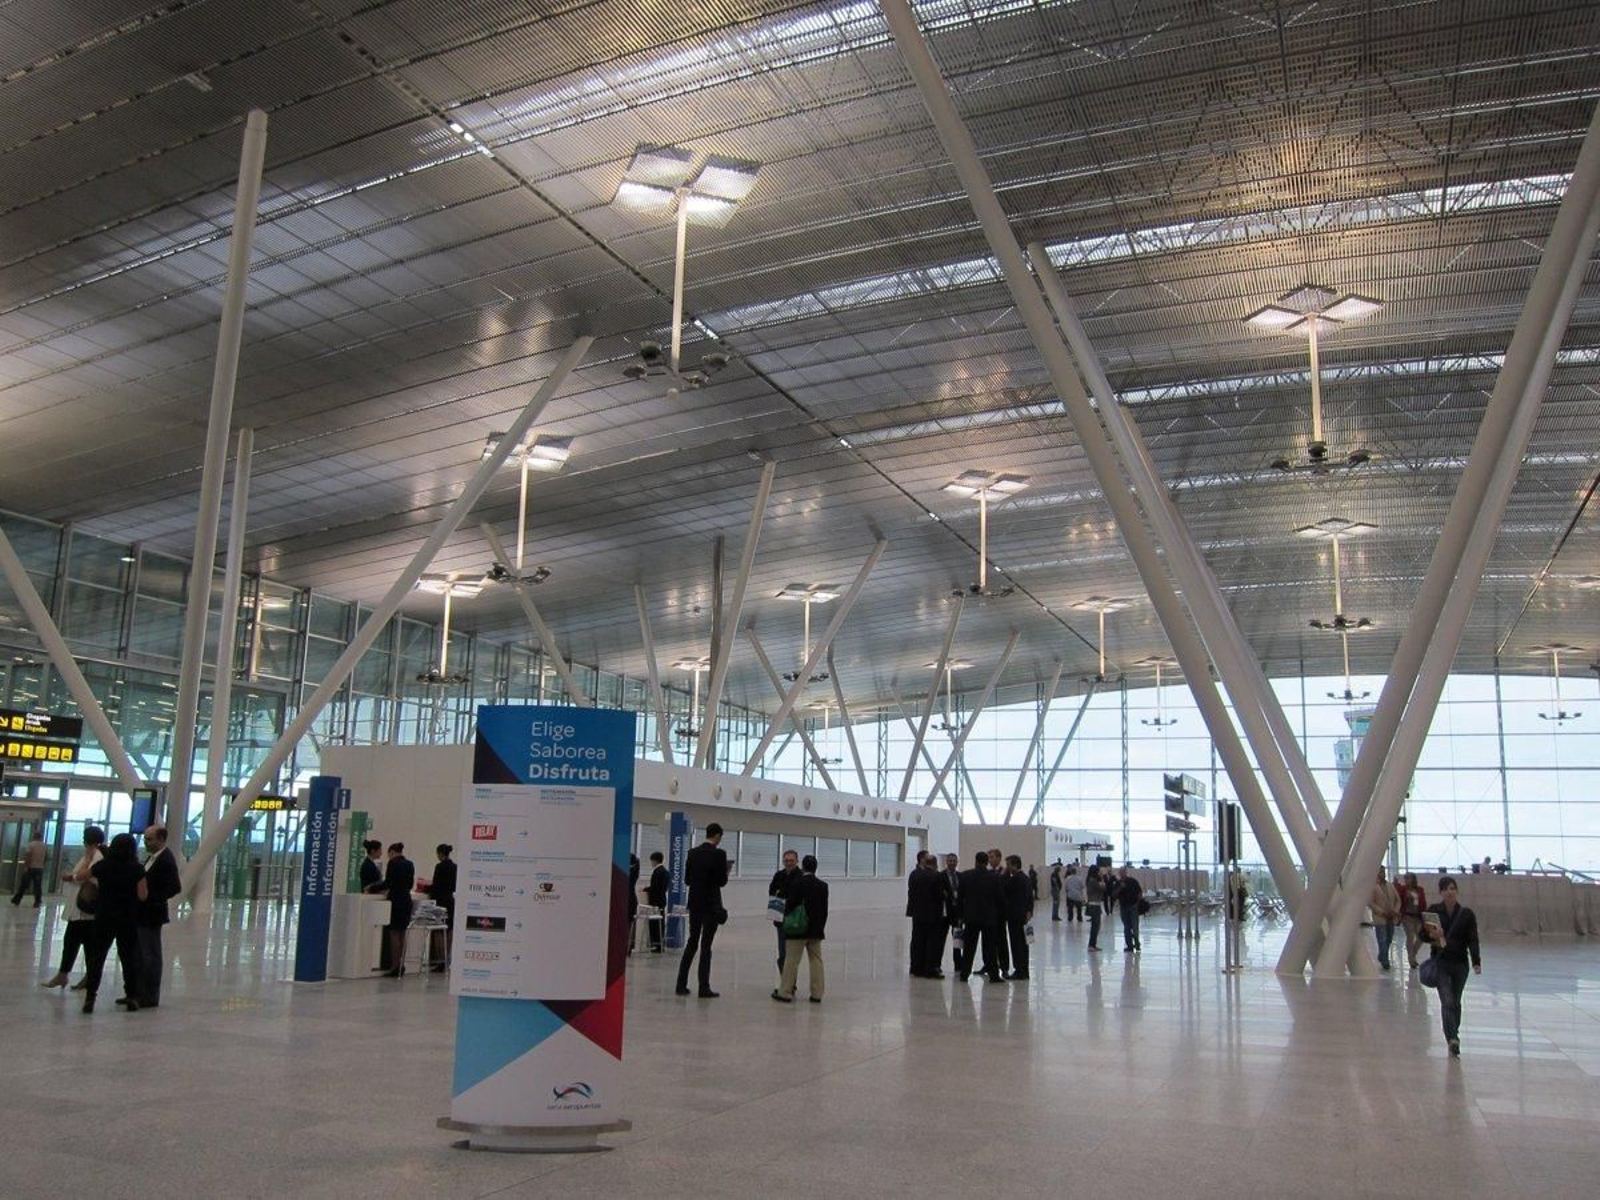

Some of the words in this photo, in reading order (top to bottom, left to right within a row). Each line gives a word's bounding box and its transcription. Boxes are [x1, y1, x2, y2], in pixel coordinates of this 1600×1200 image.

[531, 721, 575, 741] Elige
[529, 742, 606, 760] Saborea
[529, 763, 610, 781] Disfruta
[306, 811, 323, 896] Información
[322, 812, 337, 896] Información
[671, 836, 681, 893] Información
